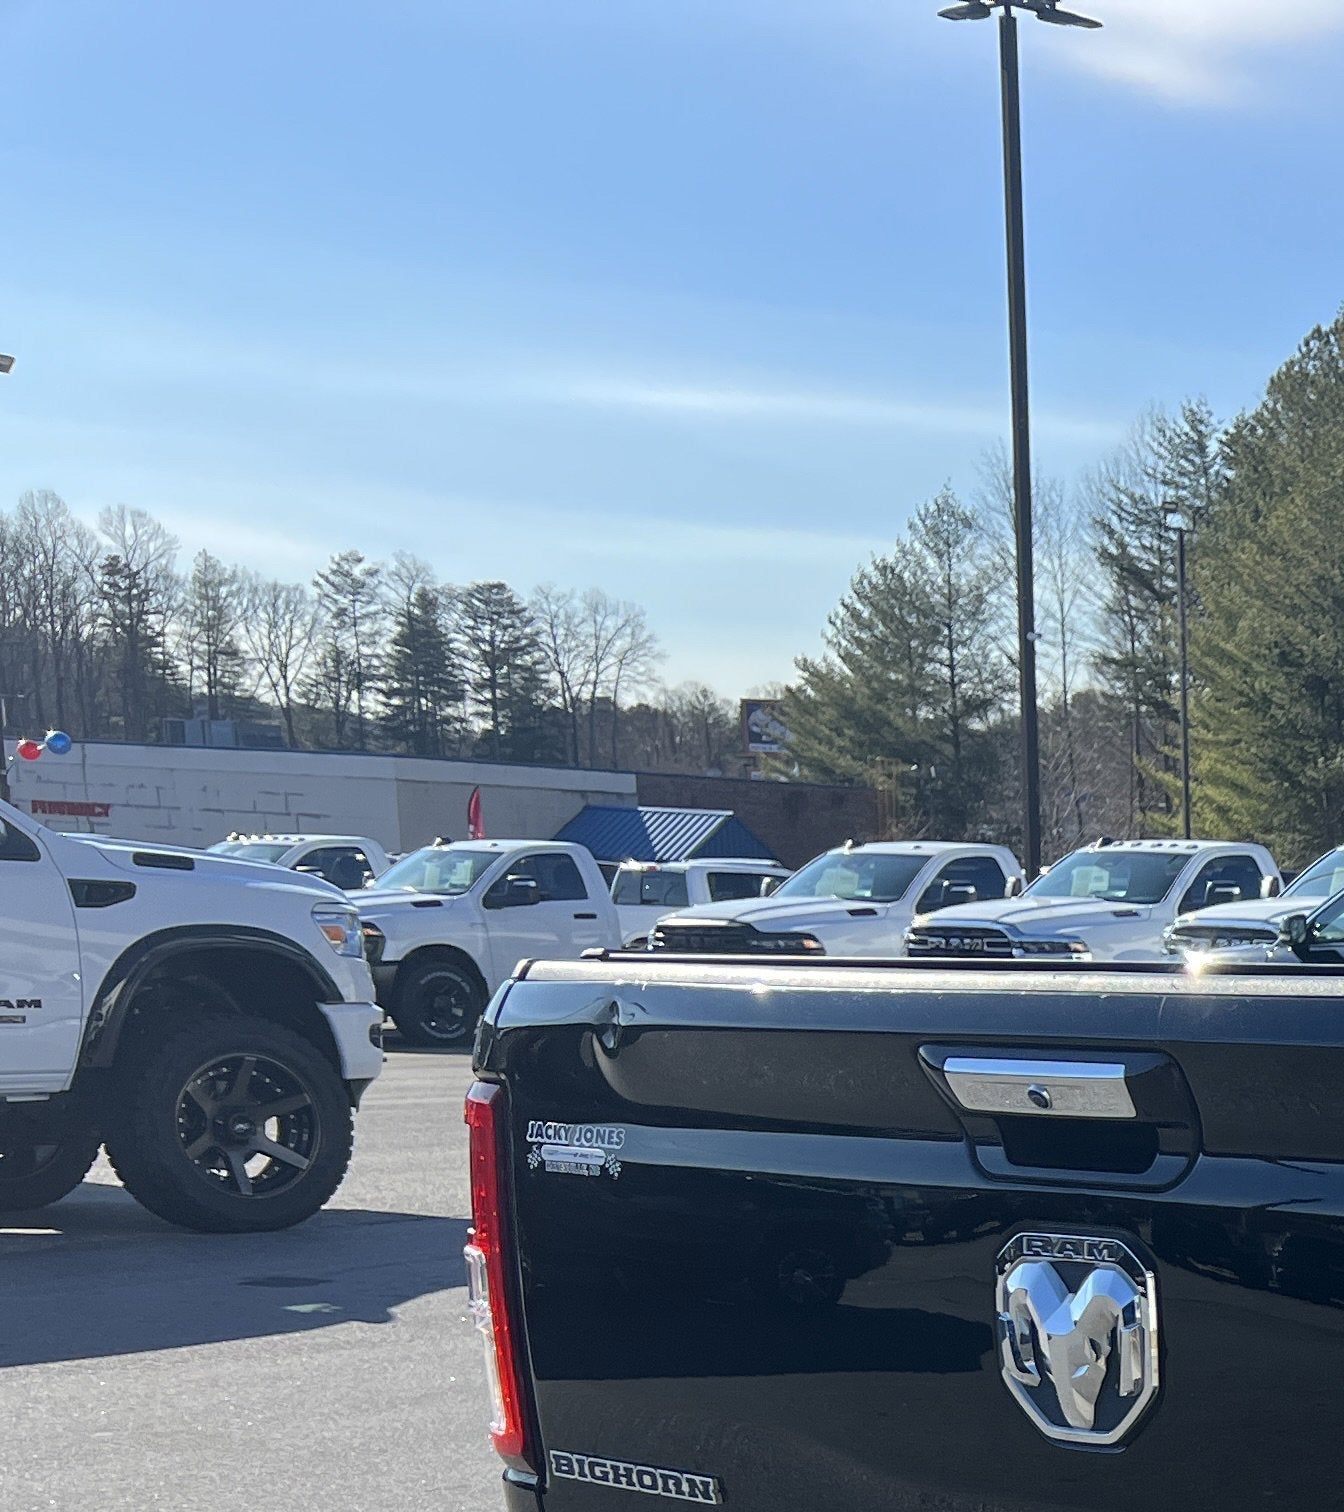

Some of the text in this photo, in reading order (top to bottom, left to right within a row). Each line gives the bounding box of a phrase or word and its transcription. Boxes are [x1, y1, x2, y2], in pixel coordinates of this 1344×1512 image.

[0, 999, 42, 1009] AM
[526, 1120, 625, 1149] JACKY JONES
[1022, 1236, 1119, 1262] RAM
[550, 1450, 724, 1505] BIGHORN
